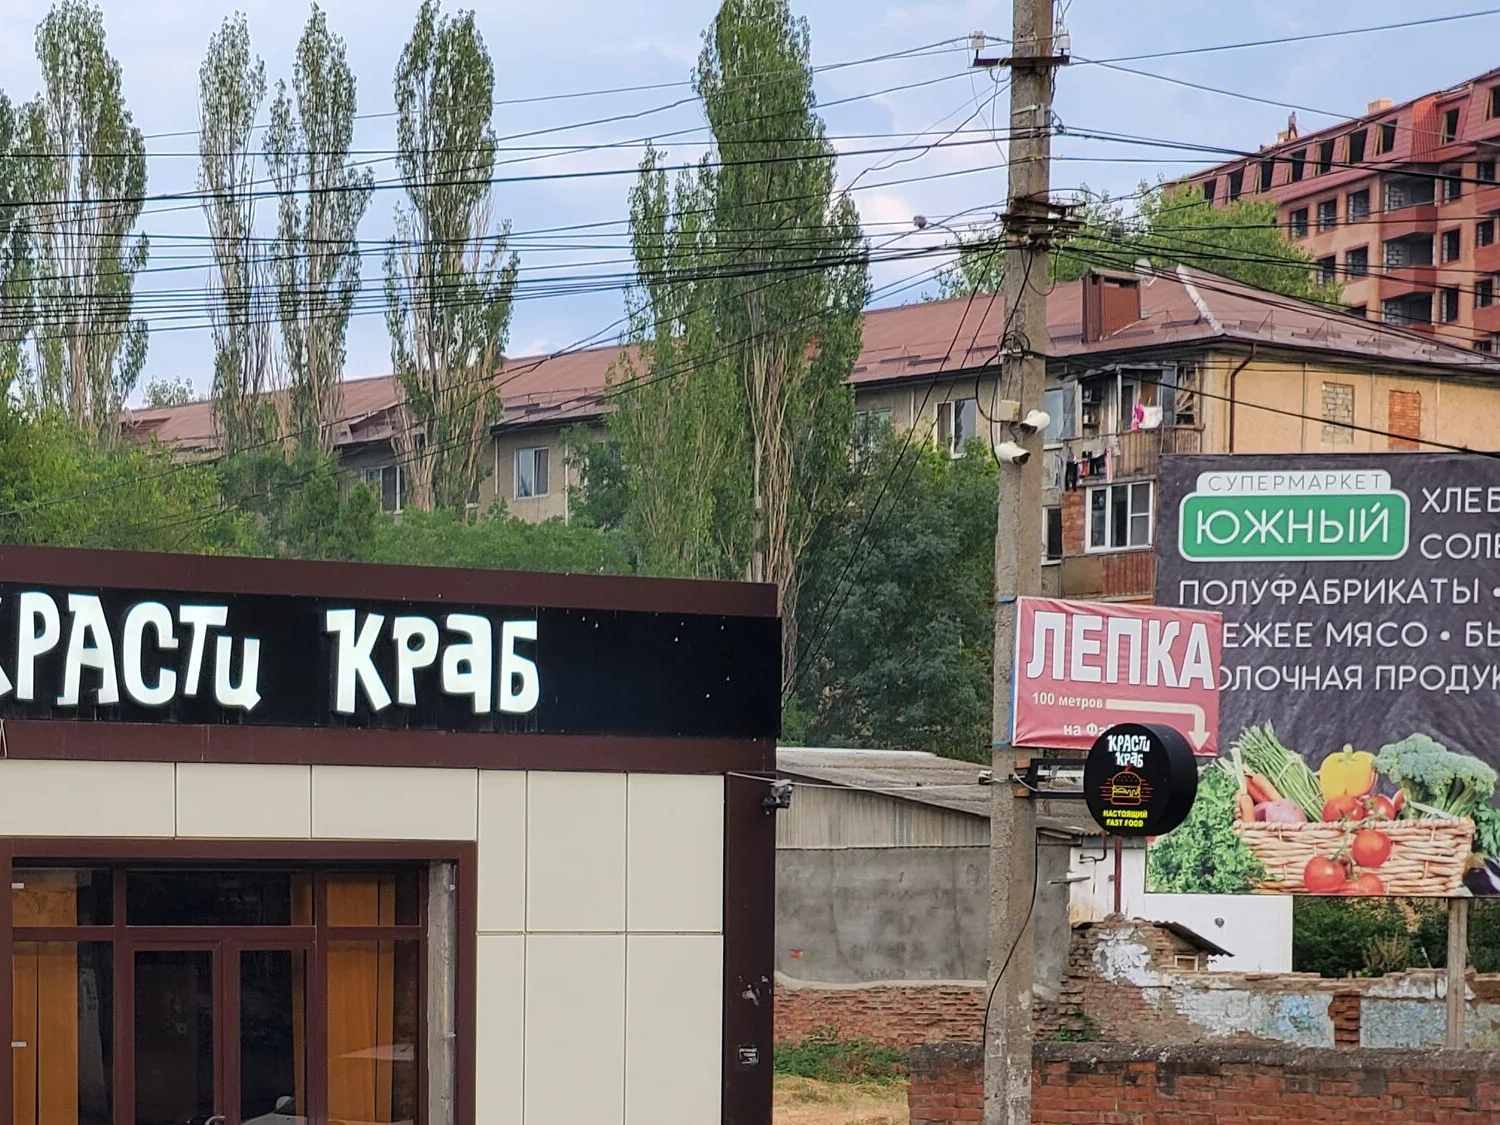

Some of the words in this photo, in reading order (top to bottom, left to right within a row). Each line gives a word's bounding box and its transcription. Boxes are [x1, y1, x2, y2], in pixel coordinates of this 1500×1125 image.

[1207, 473, 1383, 492] СУПЕРМАРКЕТ
[1196, 502, 1389, 544] ЮЖНЫЙ
[1179, 576, 1479, 605] ПОЛУФАБРИКАТЫ
[1326, 621, 1428, 648] МЯСО
[1025, 611, 1216, 690] ЛЕПКА
[1032, 691, 1055, 706] 100
[1059, 696, 1104, 710] метров
[1063, 724, 1081, 736] на
[1103, 809, 1148, 819] НАСТОЯЩИЙ
[1106, 818, 1123, 827] FAST
[1124, 819, 1144, 827] FOOD
